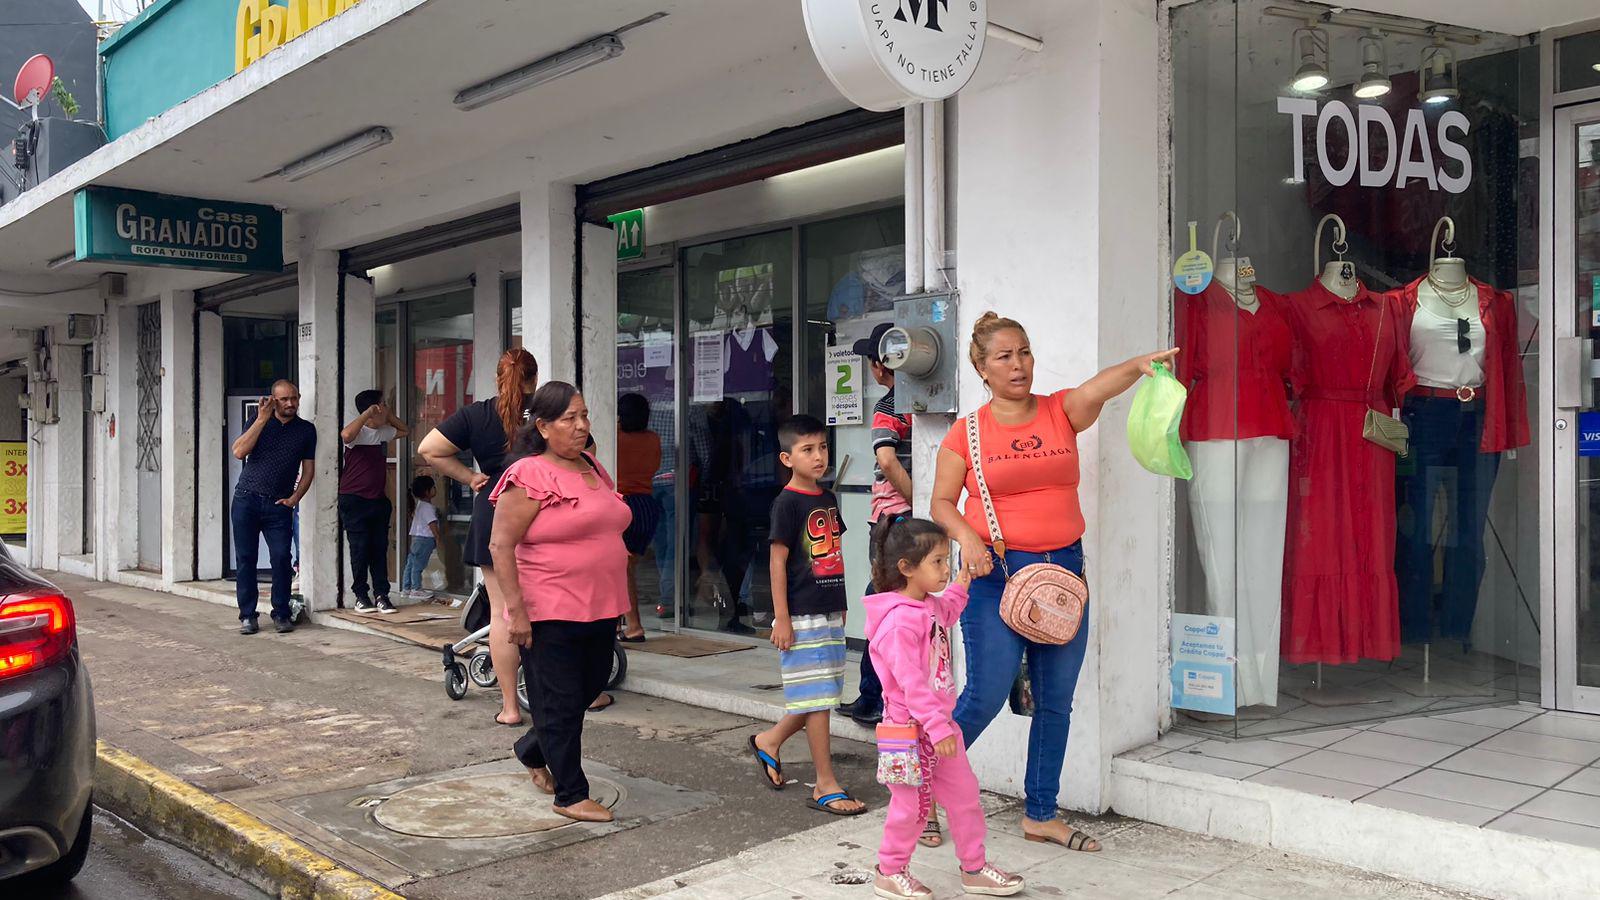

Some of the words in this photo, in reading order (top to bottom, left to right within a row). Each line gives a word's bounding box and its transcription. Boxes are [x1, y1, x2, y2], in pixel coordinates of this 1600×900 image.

[897, 54, 915, 75] NO
[921, 64, 955, 82] TIENE
[956, 20, 977, 67] TALLA
[1277, 96, 1472, 193] TODAS
[116, 203, 258, 250] GRANADOS
[197, 207, 258, 225] Casa
[136, 245, 165, 256] ROPA
[169, 247, 177, 256] Y
[179, 249, 243, 262] UNIFORMES
[836, 365, 852, 394] 2
[832, 394, 857, 404] meses
[988, 447, 1072, 463] BALENCIAGA
